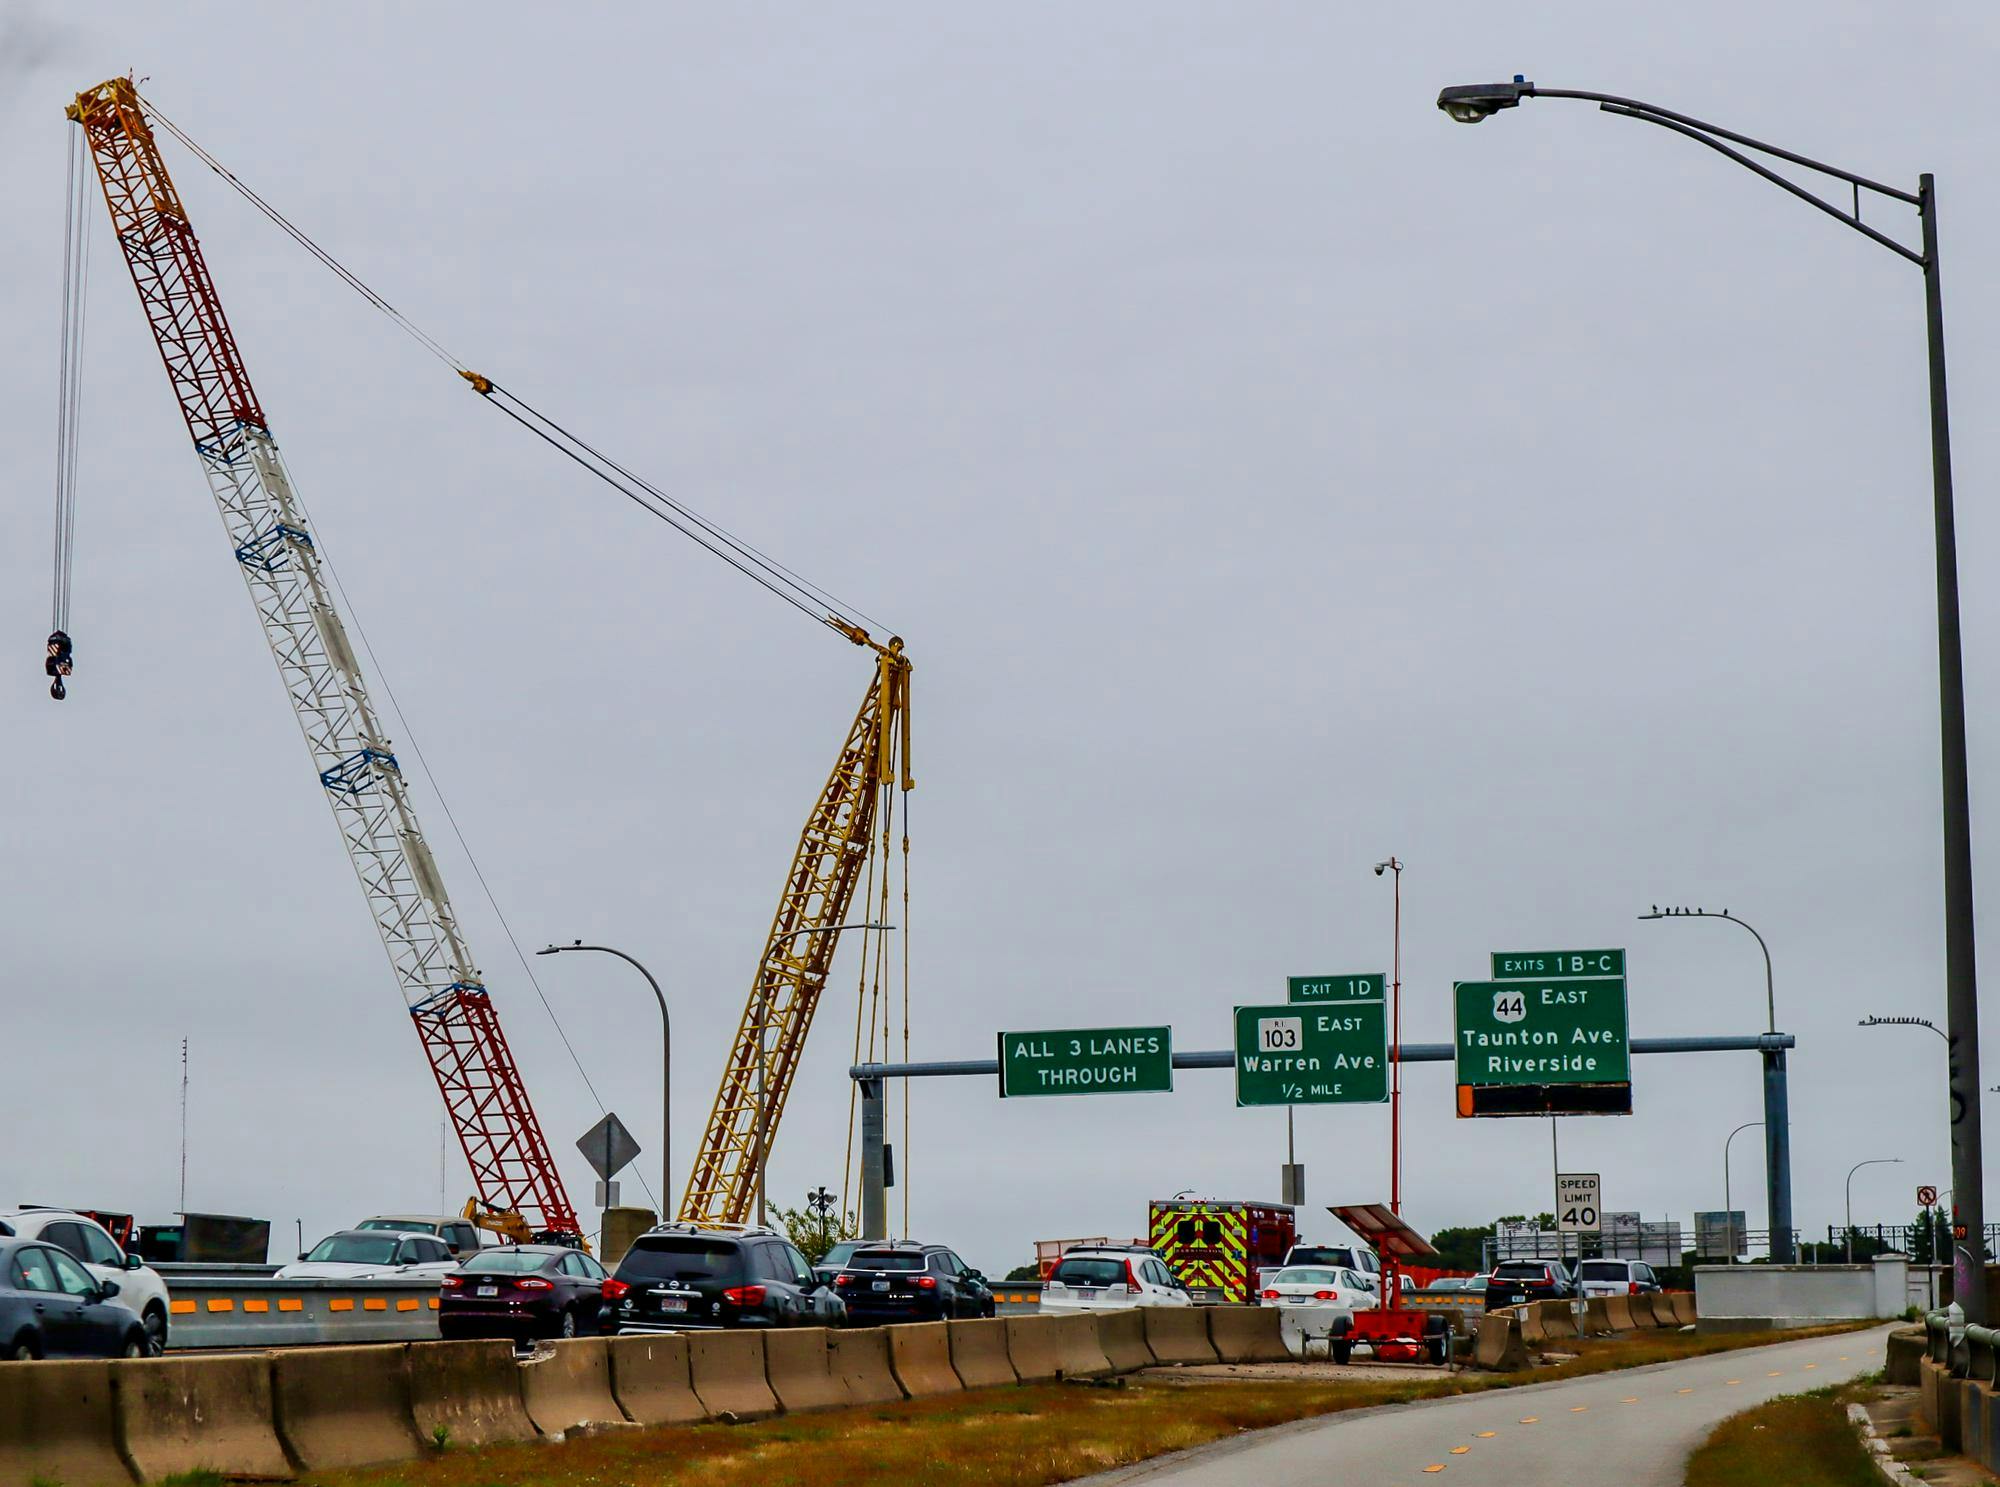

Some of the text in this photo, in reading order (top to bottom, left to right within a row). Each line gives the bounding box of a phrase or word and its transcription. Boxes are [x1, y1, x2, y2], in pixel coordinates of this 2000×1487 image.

[1505, 960, 1544, 971] EXITS
[1303, 980, 1370, 995] EXIT 1D
[1542, 989, 1587, 1004] EAST
[1496, 998, 1523, 1016] 44
[1318, 1017, 1362, 1031] EAST
[1265, 1029, 1295, 1047] 103
[1463, 1028, 1619, 1046] Taunton Ave.
[1015, 1037, 1159, 1058] ALL 3 LANES
[1244, 1054, 1380, 1072] Warren Ave.
[1489, 1055, 1596, 1072] Riverside
[1038, 1067, 1136, 1085] THROUGH
[1311, 1084, 1342, 1094] MILE
[1560, 1179, 1596, 1190] SPEED
[1565, 1194, 1591, 1202] LIMIT
[1562, 1207, 1596, 1226] 40
